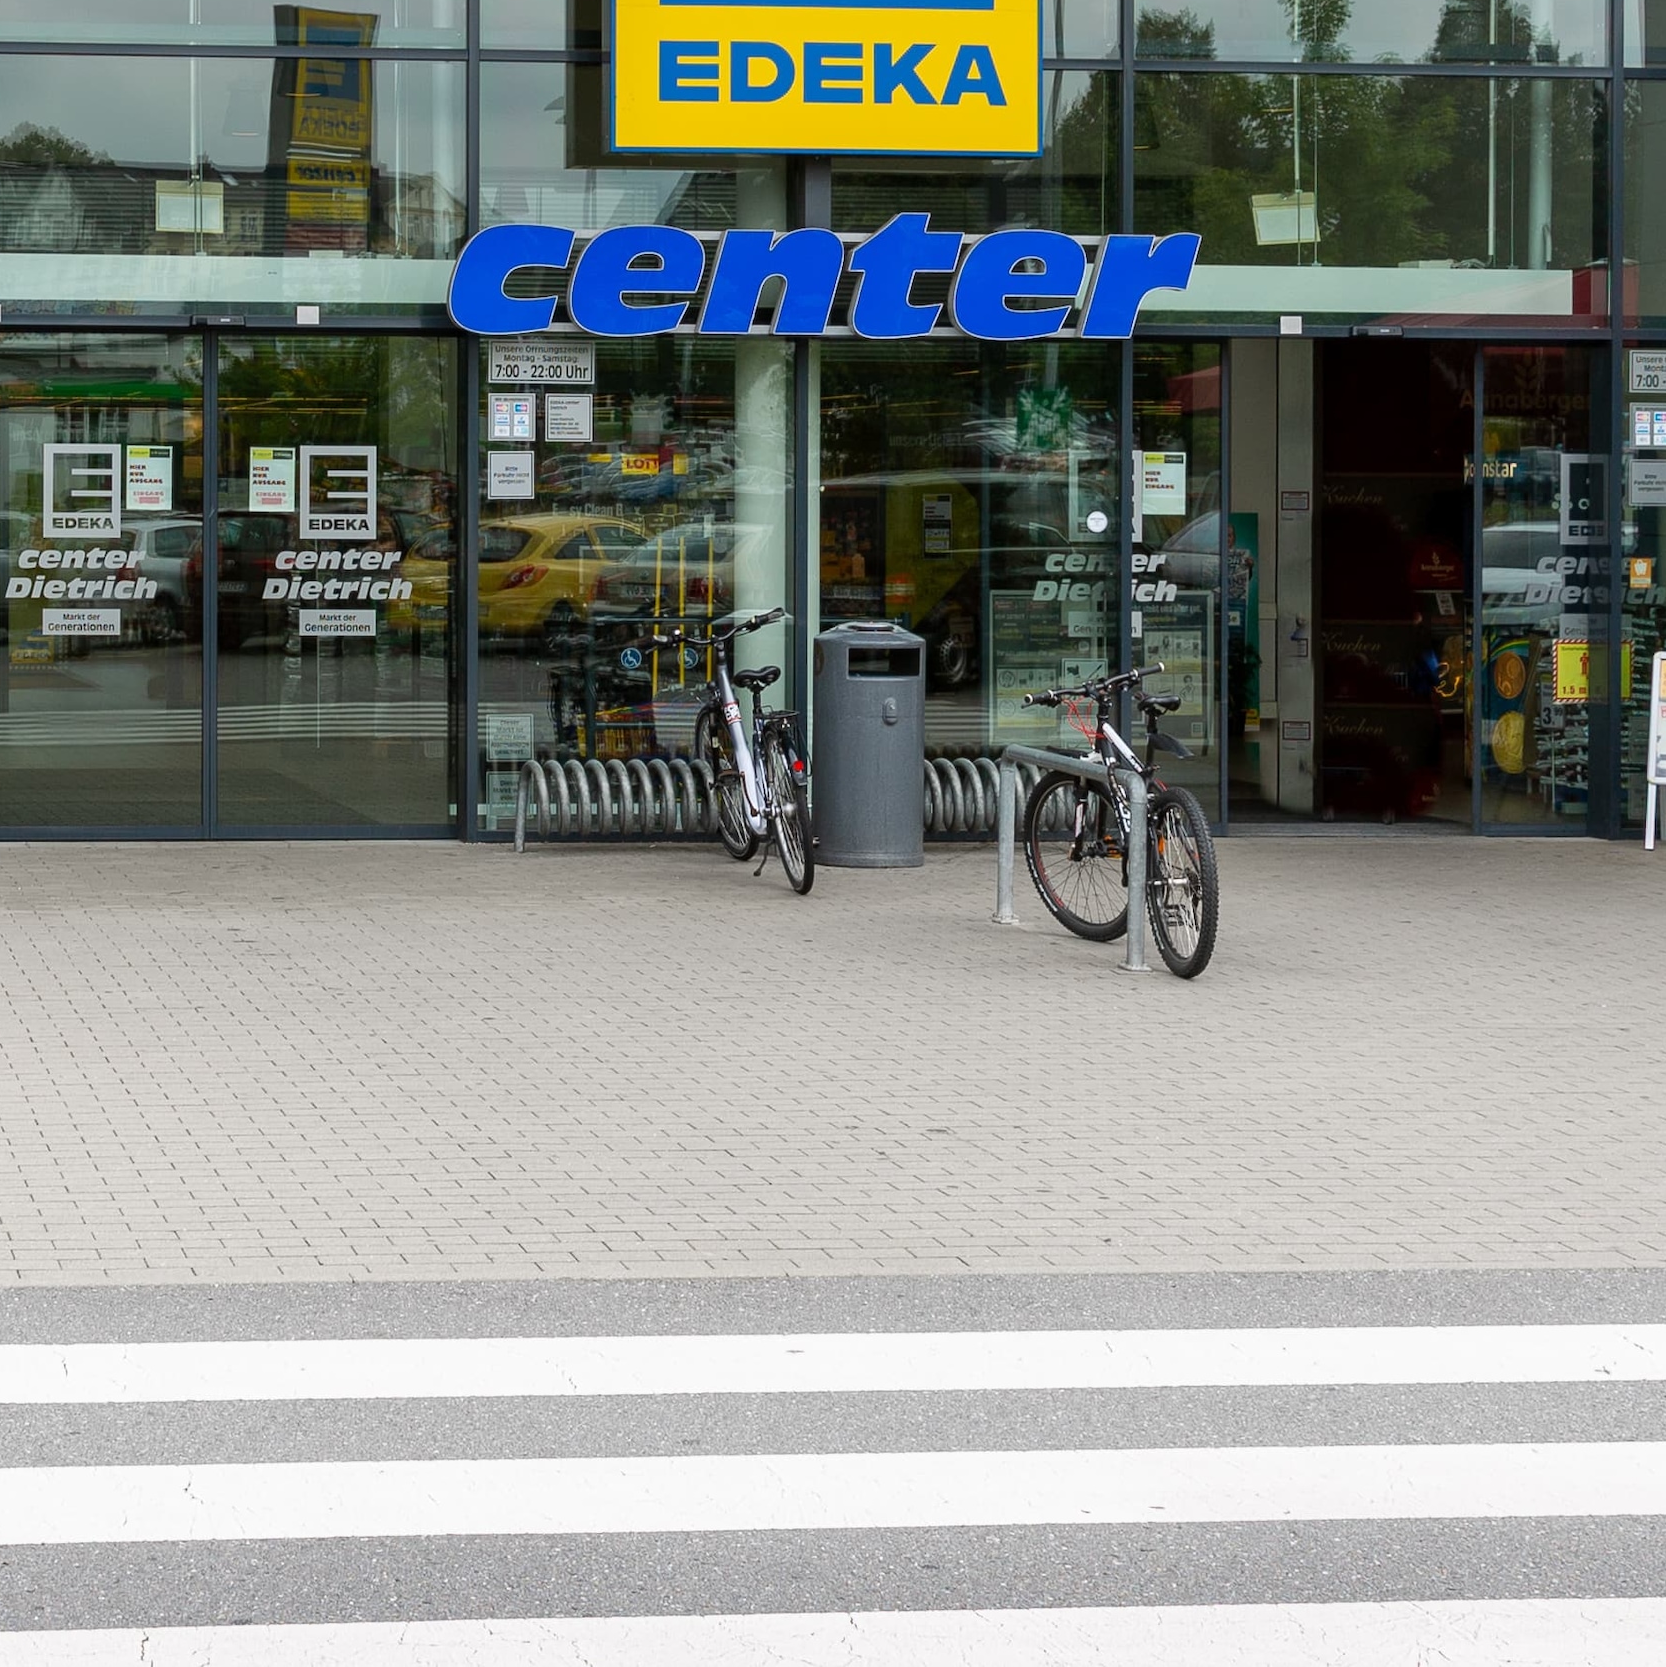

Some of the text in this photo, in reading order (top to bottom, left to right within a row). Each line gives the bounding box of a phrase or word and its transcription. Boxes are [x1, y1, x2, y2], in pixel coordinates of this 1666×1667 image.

[659, 40, 1008, 107] EDEKA
[446, 212, 1202, 341] center
[503, 355, 535, 363] Montag
[495, 364, 520, 377] 7:00
[531, 365, 562, 379] 22:00
[566, 365, 589, 379] Uhr
[1636, 375, 1660, 388] 7:00
[52, 518, 114, 529] EDEKA
[309, 519, 370, 531] EDEKA
[18, 548, 147, 569] center
[276, 548, 402, 570] center
[1045, 553, 1167, 573] cener
[5, 575, 158, 599] Dietrich
[262, 576, 413, 600] Dietrich
[87, 612, 101, 620] der
[343, 613, 357, 621] der
[48, 622, 115, 632] Generationen
[304, 623, 371, 633] Generationen
